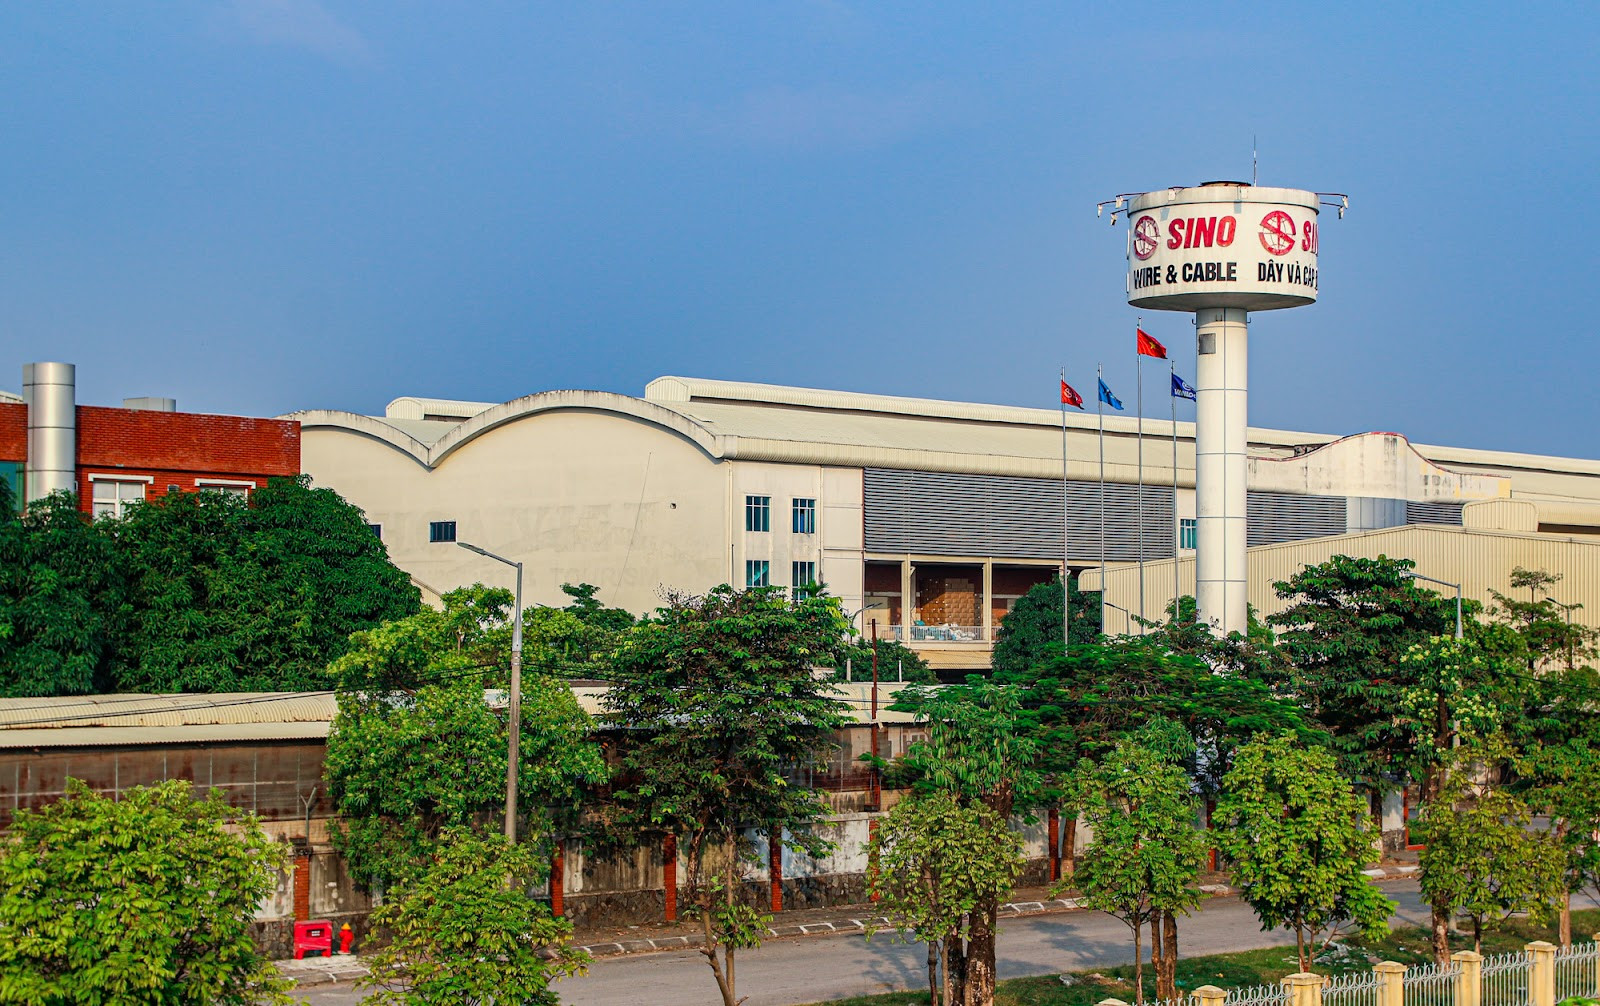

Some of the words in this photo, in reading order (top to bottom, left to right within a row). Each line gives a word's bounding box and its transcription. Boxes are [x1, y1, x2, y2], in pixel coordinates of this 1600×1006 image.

[1167, 215, 1237, 250] SINO
[1133, 265, 1161, 290] WIRE
[1165, 264, 1178, 285] &
[1182, 261, 1237, 283] CABLE
[1258, 258, 1284, 283] DÂY
[1287, 260, 1302, 285] VÀ
